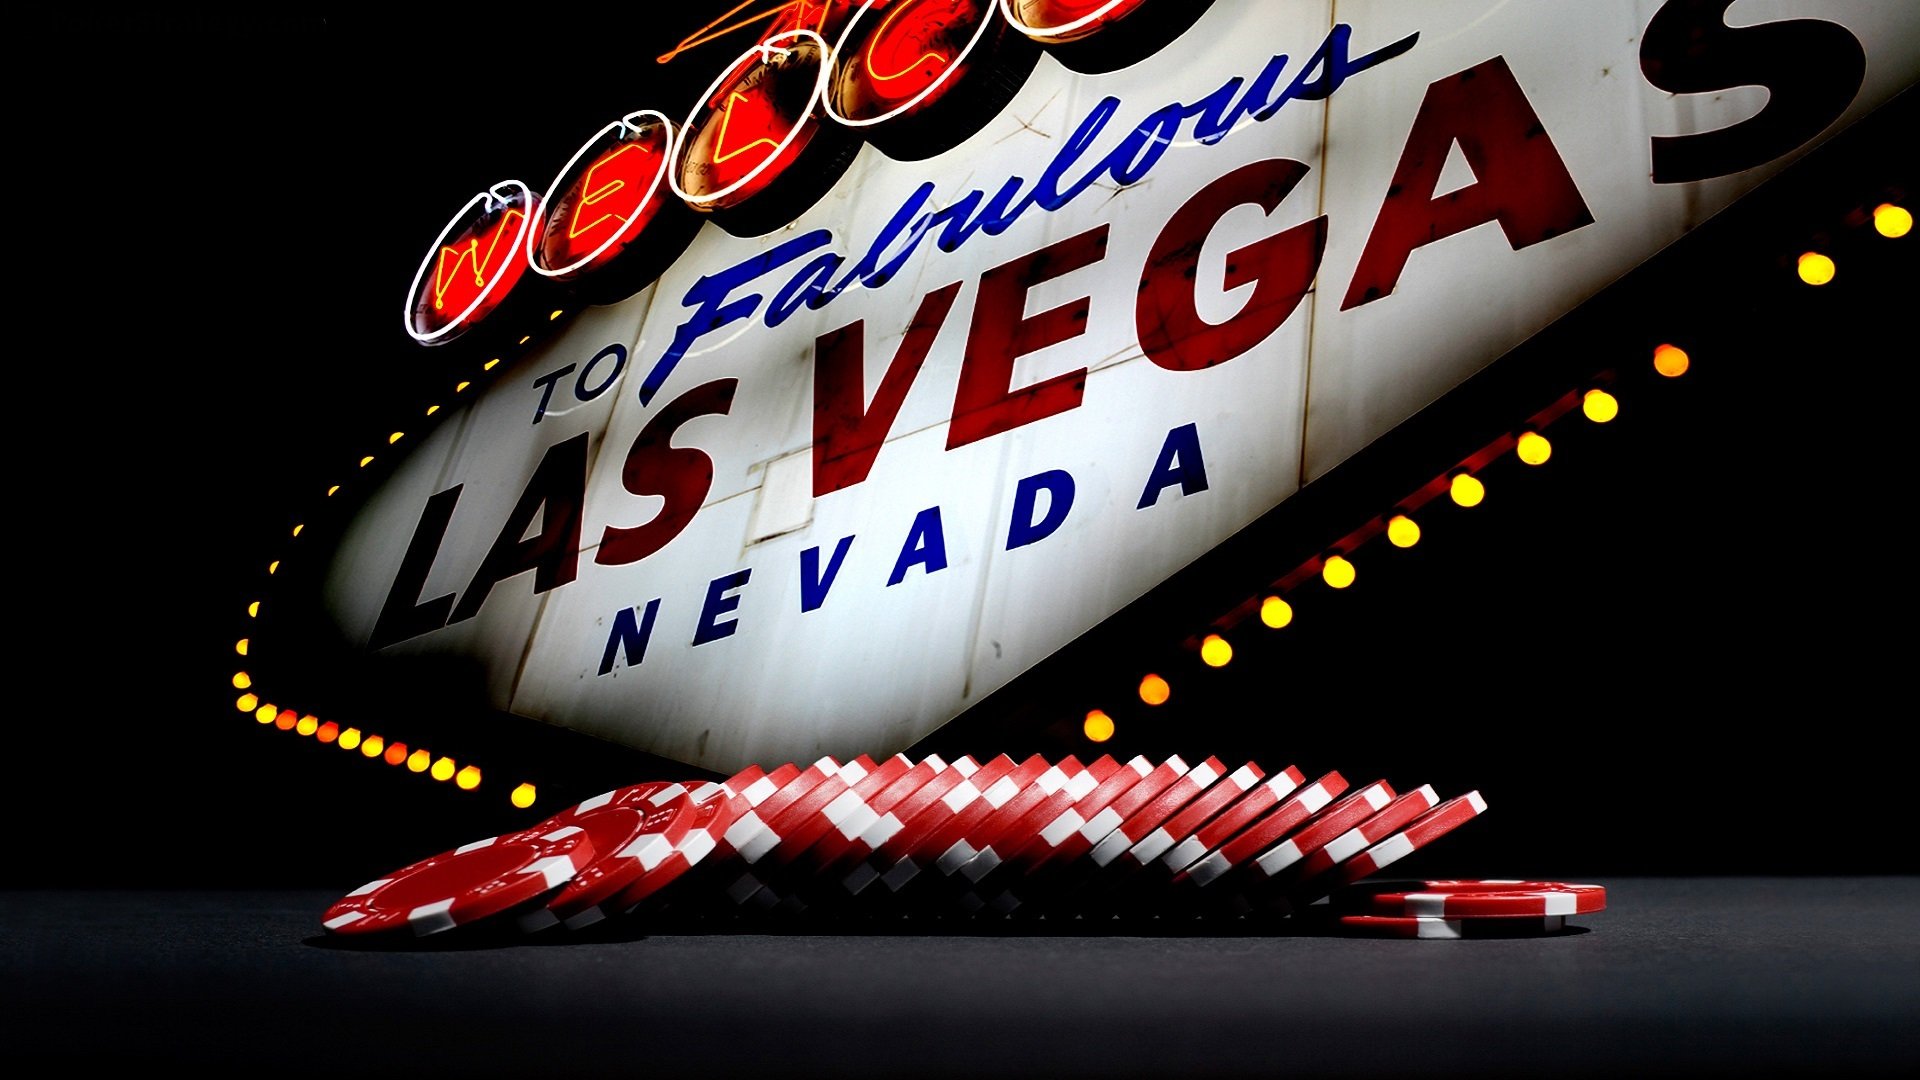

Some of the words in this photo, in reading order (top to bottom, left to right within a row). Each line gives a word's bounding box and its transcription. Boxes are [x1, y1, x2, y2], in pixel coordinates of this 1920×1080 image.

[368, 377, 740, 652] LAS
[812, 0, 1868, 498] VEGAS
[415, 0, 1112, 322] WELC
[532, 343, 629, 426] TO
[640, 22, 1420, 407] Fabulous
[597, 422, 1209, 677] NEVADA
